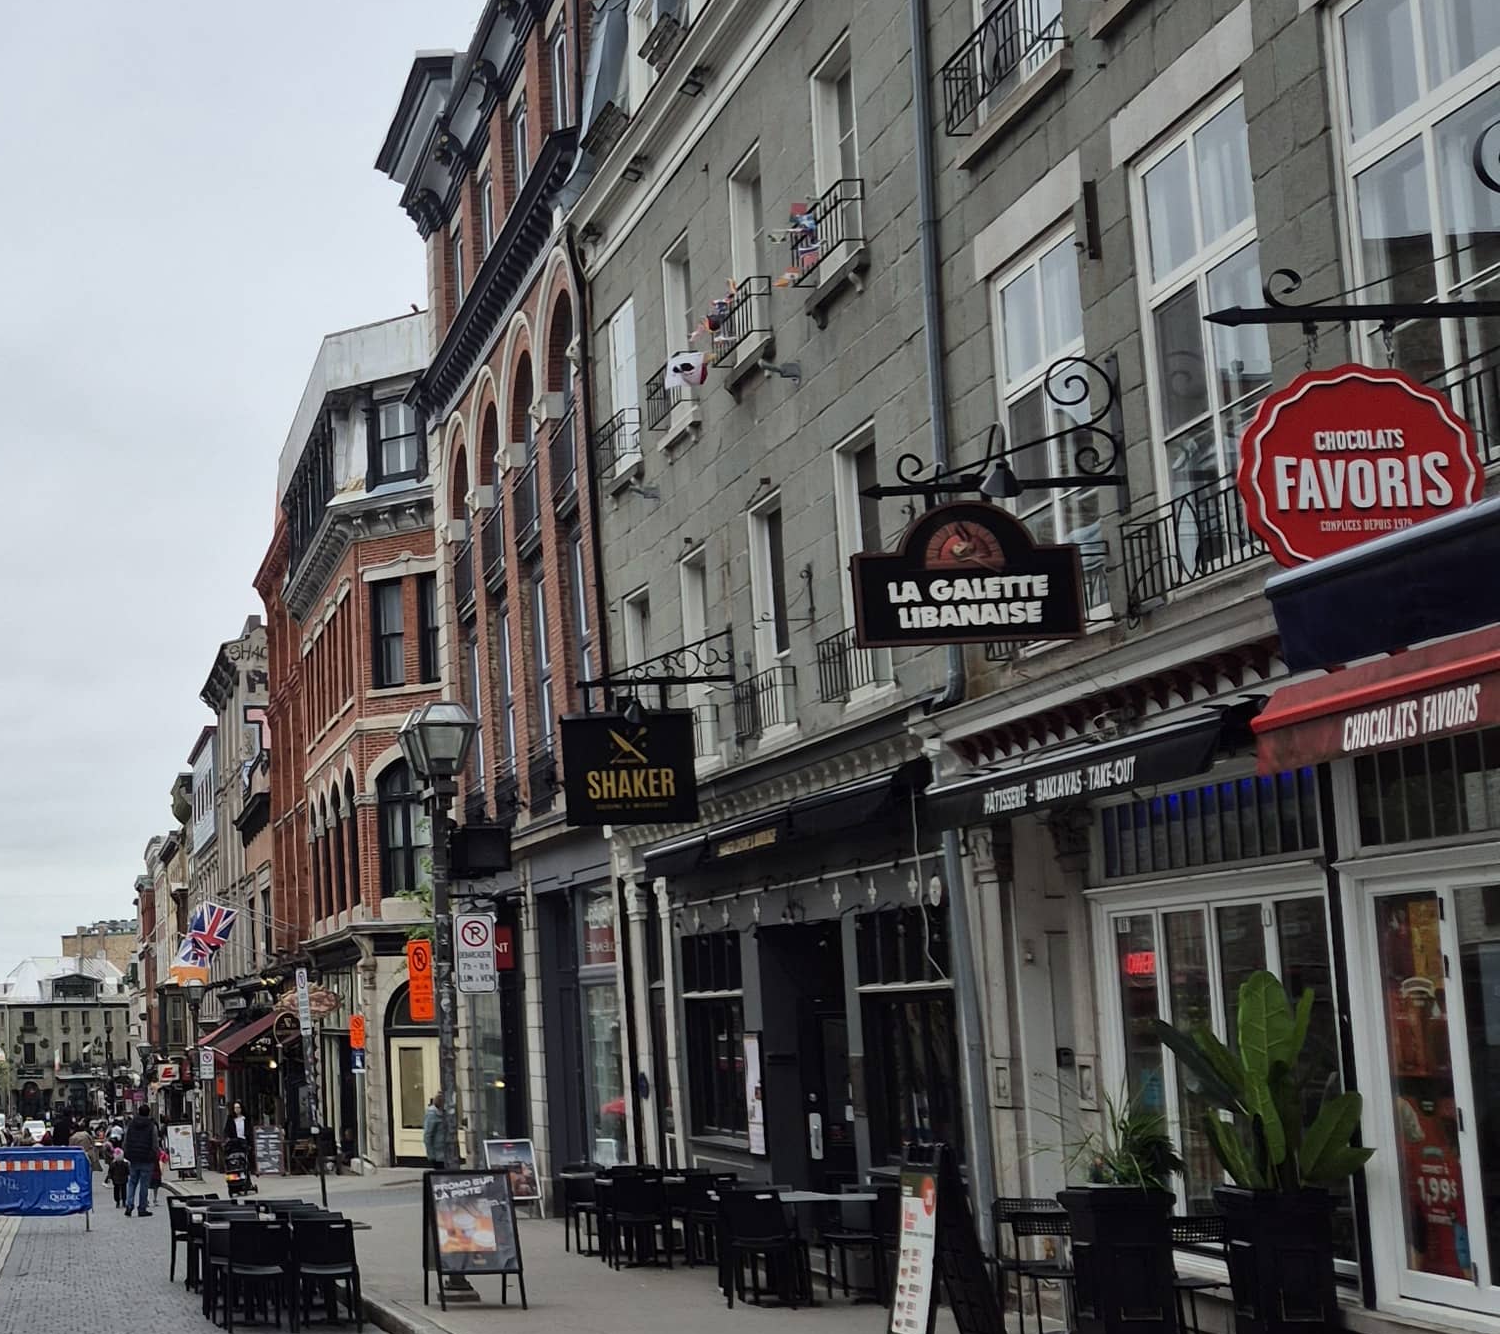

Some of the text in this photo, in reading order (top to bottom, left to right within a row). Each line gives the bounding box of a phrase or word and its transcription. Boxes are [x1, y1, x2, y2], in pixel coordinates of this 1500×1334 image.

[1314, 429, 1405, 451] CHOCOLATS
[1274, 451, 1453, 511] FAVORIS
[1320, 519, 1361, 532] COMPLICES
[1364, 519, 1392, 531] DEPUIS
[887, 574, 1049, 603] LA GALETTE
[898, 601, 1043, 629] LIBANAISE
[1342, 683, 1481, 752] CHOCOLATS FAVORIS
[587, 768, 675, 799] SHAKER
[1035, 770, 1082, 803] BAKLAVAS
[1088, 755, 1136, 791] TAKE-OUT
[433, 1179, 471, 1192] PROMO
[434, 1186, 482, 1200] LA PINTE
